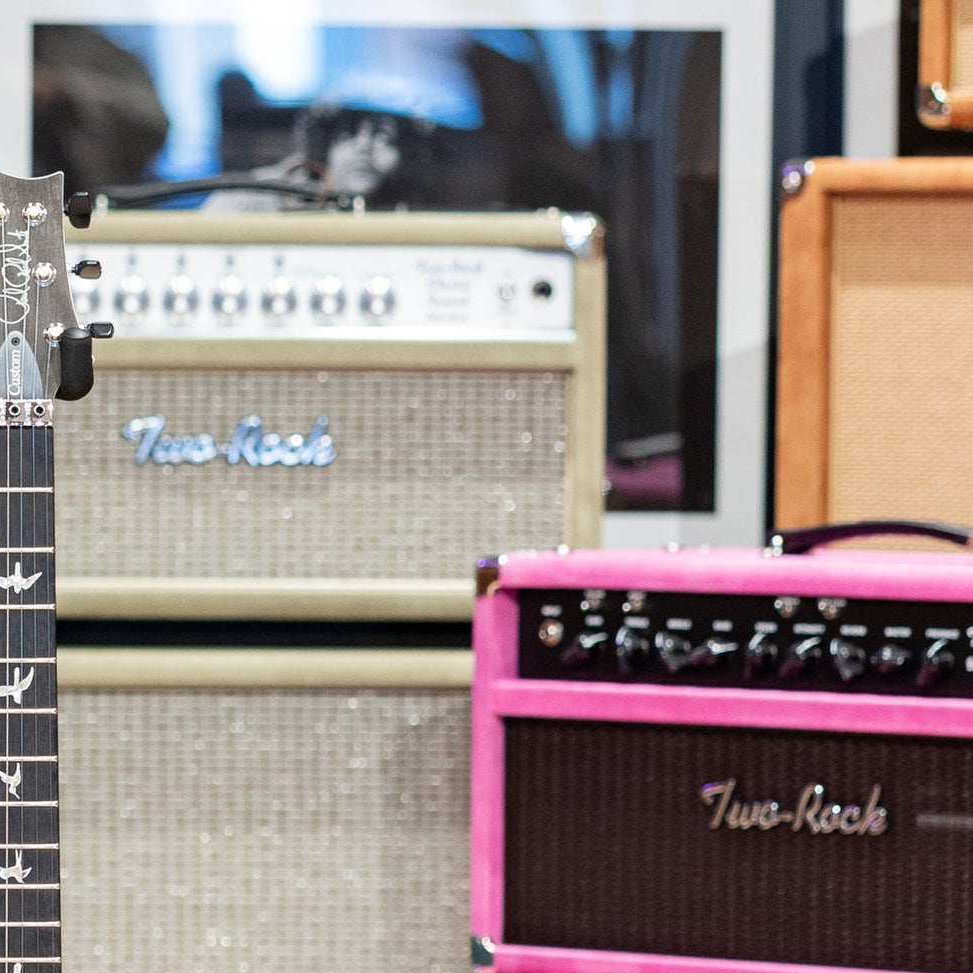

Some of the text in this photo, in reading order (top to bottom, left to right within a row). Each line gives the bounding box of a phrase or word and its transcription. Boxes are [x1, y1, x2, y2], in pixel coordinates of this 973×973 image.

[8, 349, 21, 396] Custom
[123, 414, 337, 467] Two-Rock
[701, 778, 888, 836] Two-Rock
